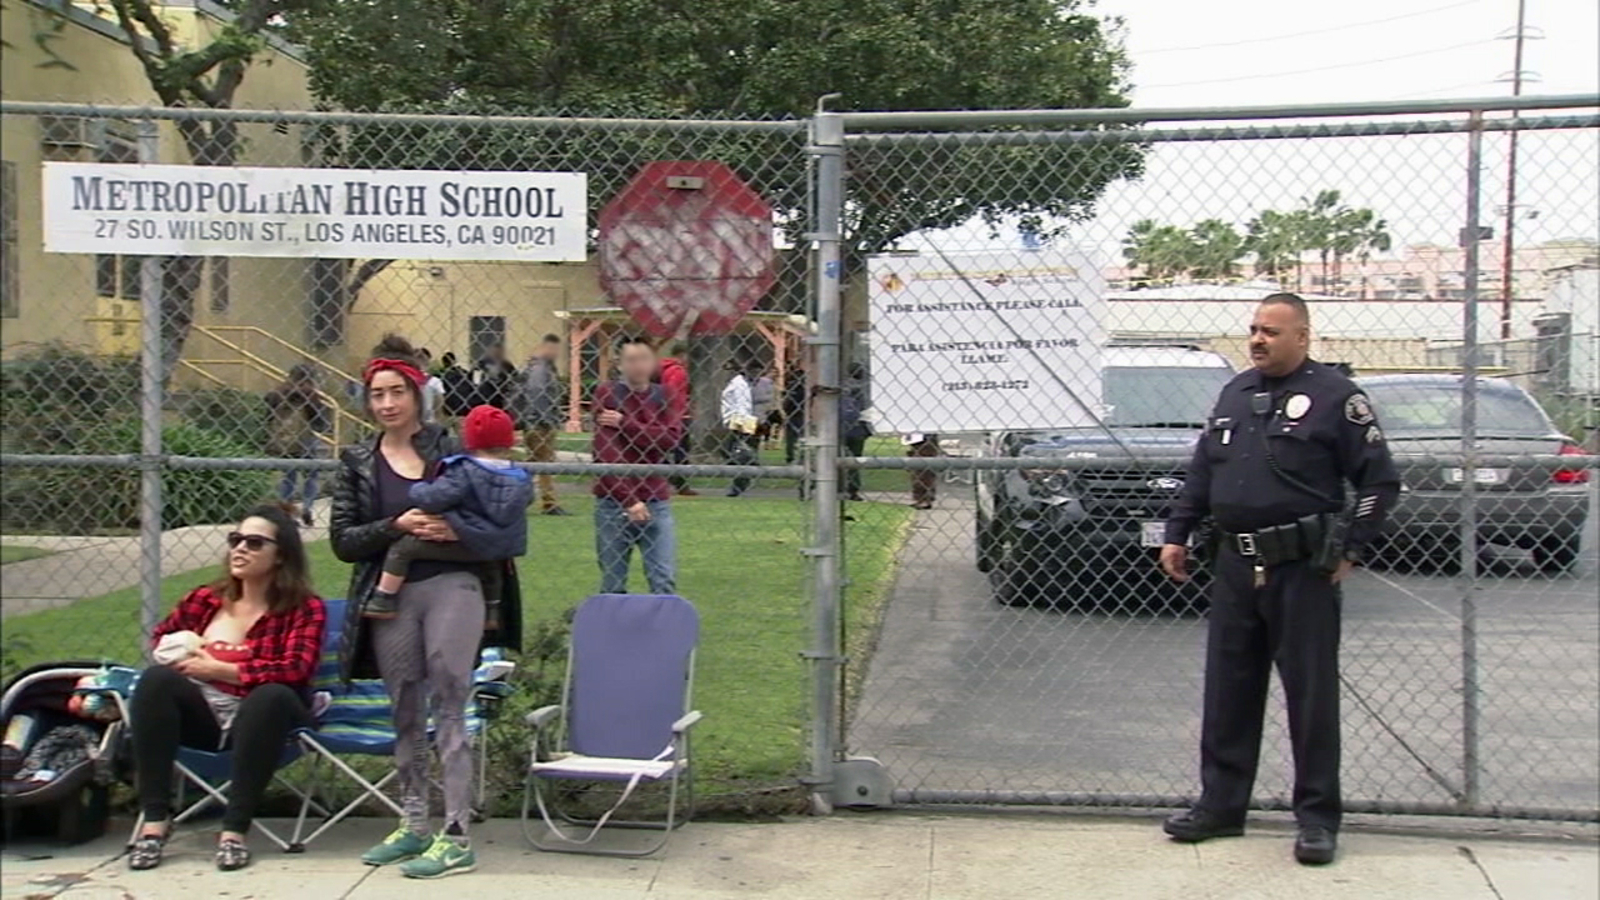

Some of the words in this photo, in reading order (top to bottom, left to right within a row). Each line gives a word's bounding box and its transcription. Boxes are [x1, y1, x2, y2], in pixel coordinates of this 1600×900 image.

[71, 175, 333, 215] METROPOLITAN
[343, 181, 427, 216] HIGH
[440, 181, 564, 218] SCHOOL
[94, 218, 119, 239] 27
[126, 219, 163, 240] SO.
[167, 219, 254, 241] WILSON
[305, 222, 345, 243] LOS
[352, 222, 453, 248] ANGELES,
[457, 225, 486, 244] CA
[492, 225, 556, 246] 90021
